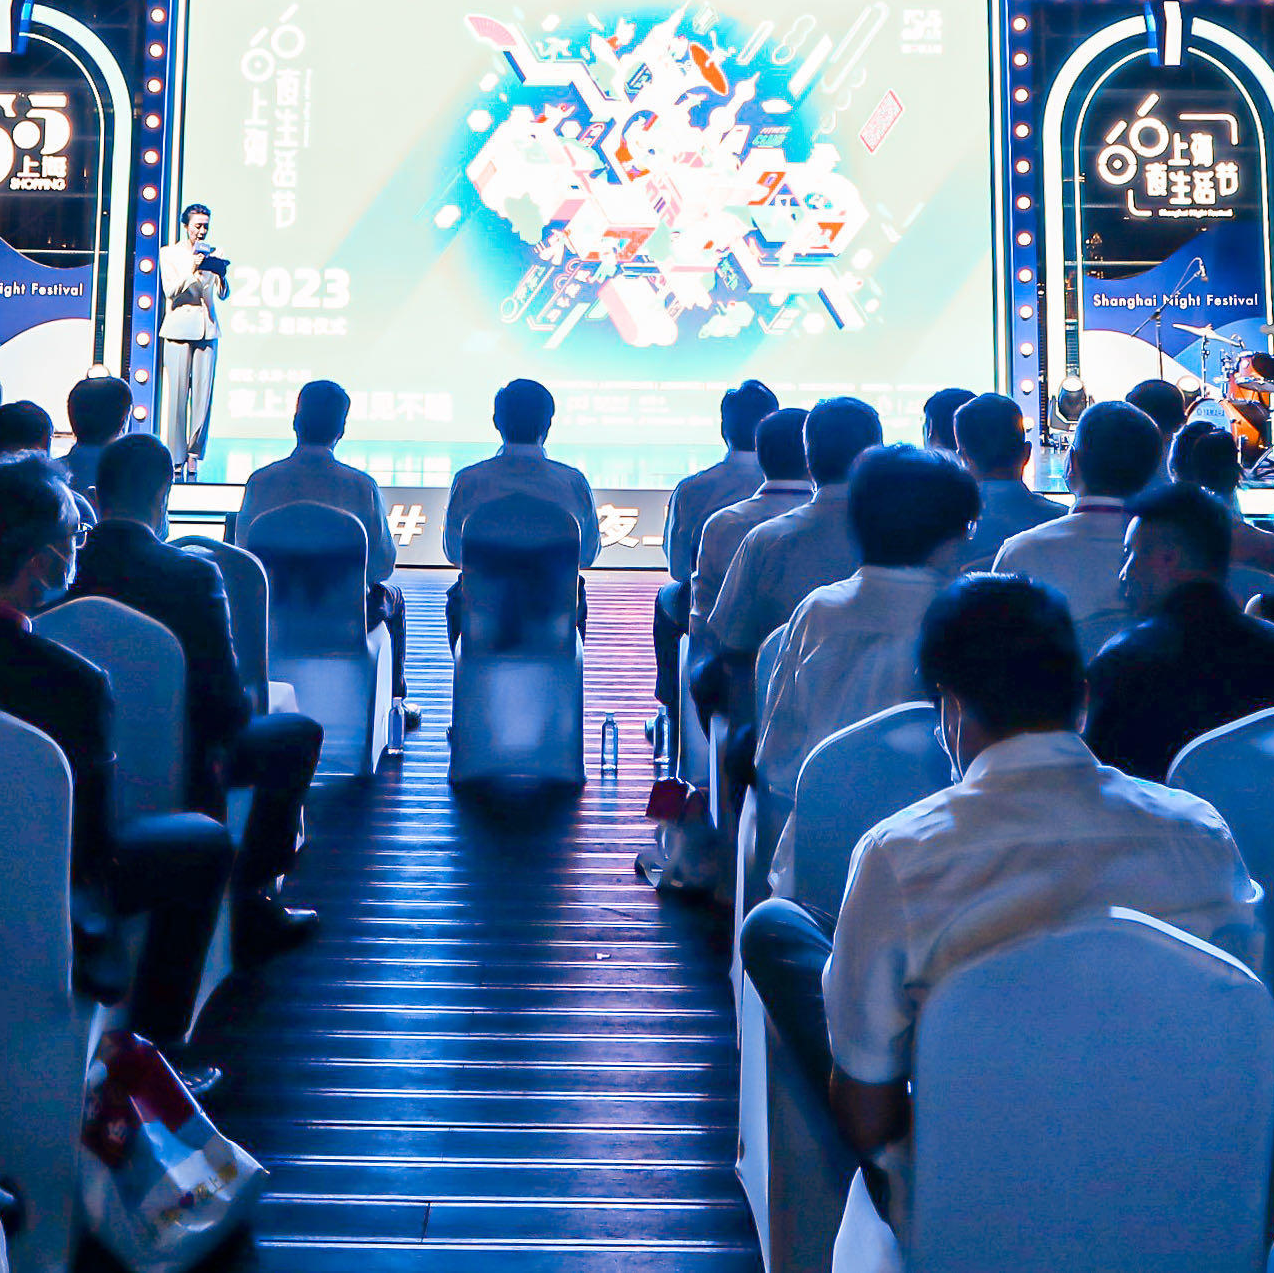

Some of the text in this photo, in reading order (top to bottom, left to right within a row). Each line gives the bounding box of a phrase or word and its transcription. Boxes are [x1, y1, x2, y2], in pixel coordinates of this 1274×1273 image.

[17, 155, 68, 178] 上海
[1145, 161, 1240, 205] 夜生活节
[31, 282, 84, 297] Festival
[230, 266, 351, 309] 2023
[1092, 293, 1259, 309] Shanghai Night Festival
